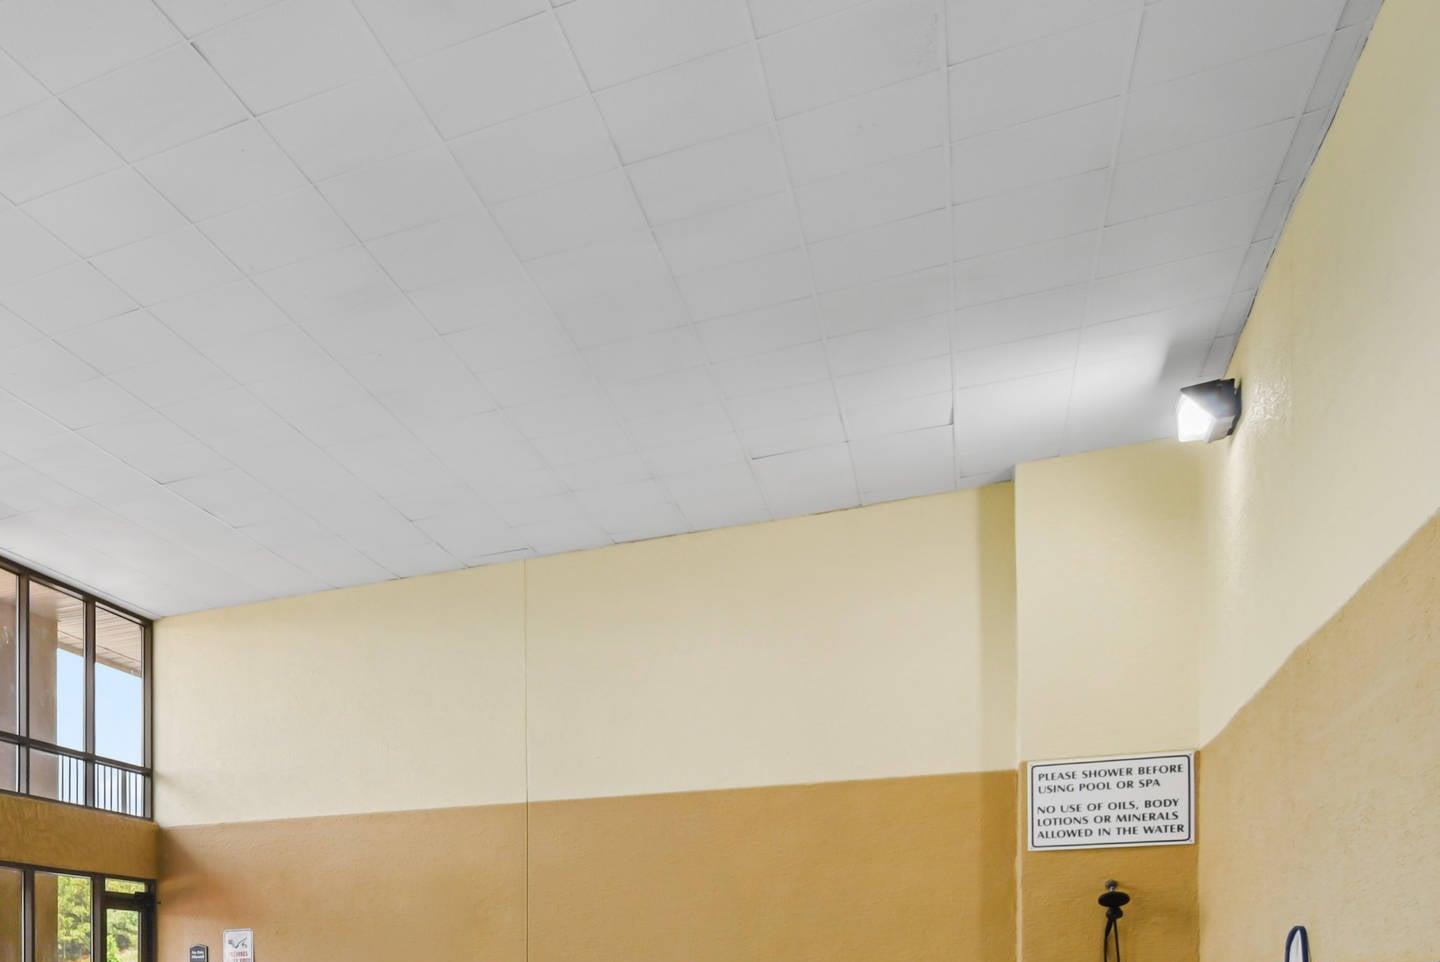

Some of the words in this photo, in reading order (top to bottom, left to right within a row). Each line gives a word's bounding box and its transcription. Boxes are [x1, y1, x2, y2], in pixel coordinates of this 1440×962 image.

[1038, 770, 1077, 782] PLEASE
[1082, 767, 1133, 779] SHOWER
[1138, 764, 1184, 775] BEFORE
[1038, 783, 1074, 794] USING
[1079, 782, 1111, 792] POOL
[1116, 780, 1134, 789] OR
[1139, 778, 1161, 788] SPA
[1037, 805, 1056, 814] NO
[1060, 803, 1082, 813] USE
[1087, 802, 1104, 812] OF
[1108, 801, 1139, 811] OILS,
[1144, 798, 1179, 808] BODY
[1037, 815, 1088, 827] LOTIONS
[1093, 814, 1111, 824] OR
[1116, 811, 1178, 823] MINERALS
[1037, 828, 1093, 839] ALLOWED
[1098, 827, 1111, 836] IN
[1116, 826, 1138, 836] THE
[1144, 824, 1184, 834] WATER
